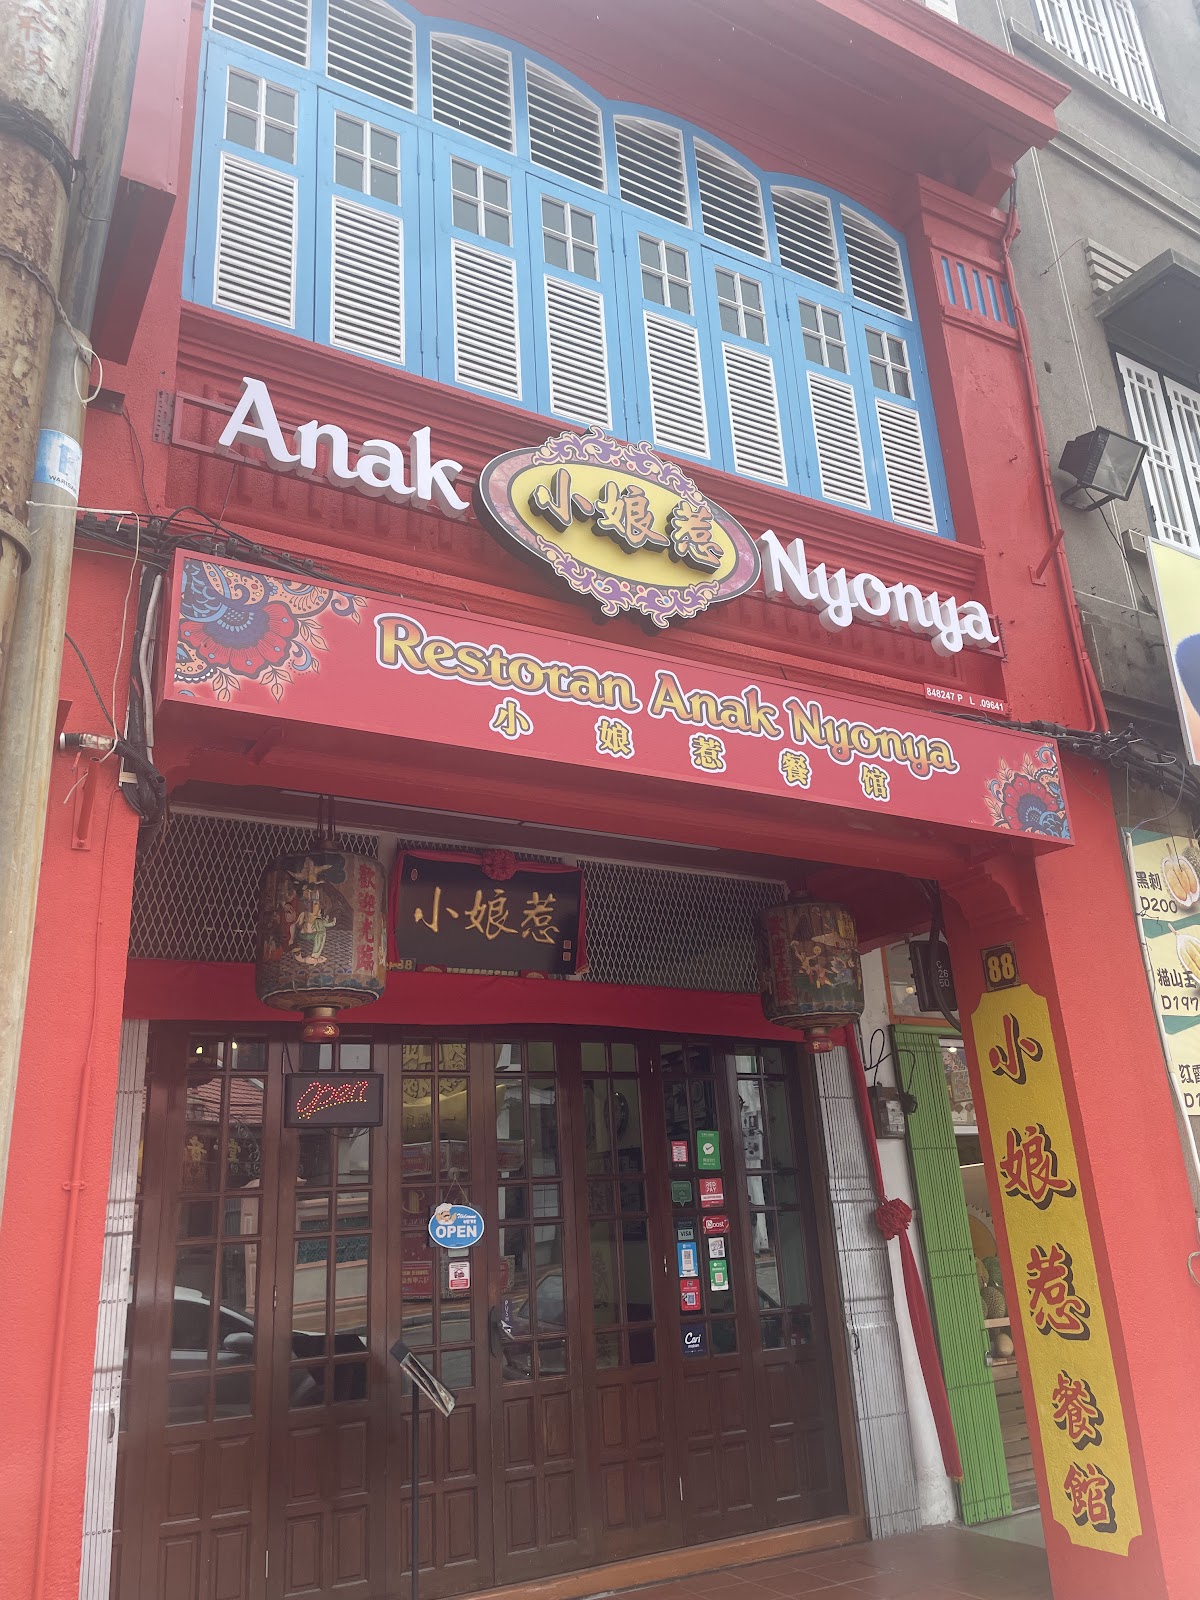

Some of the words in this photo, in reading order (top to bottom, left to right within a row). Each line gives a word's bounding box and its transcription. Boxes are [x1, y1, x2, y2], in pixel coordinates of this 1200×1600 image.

[216, 376, 470, 513] Anak
[757, 529, 1000, 655] Nyonya
[529, 467, 724, 573] 小娘惹
[375, 614, 643, 712] Restoran
[648, 670, 784, 740] Anak
[783, 696, 959, 780] Nyonya
[926, 687, 955, 701] 848247
[957, 693, 963, 702] P
[969, 696, 976, 706] L
[490, 699, 890, 801] 小娘惹餐馆
[1136, 871, 1163, 891] 黑刺
[414, 886, 562, 946] 小娘惹
[1140, 896, 1178, 914] D200
[988, 951, 1016, 983] 88
[1156, 967, 1197, 988] 猫山王
[435, 1225, 478, 1239] OPEN
[989, 1013, 1117, 1533] 小娘惹餐館
[684, 1332, 702, 1345] Cari
